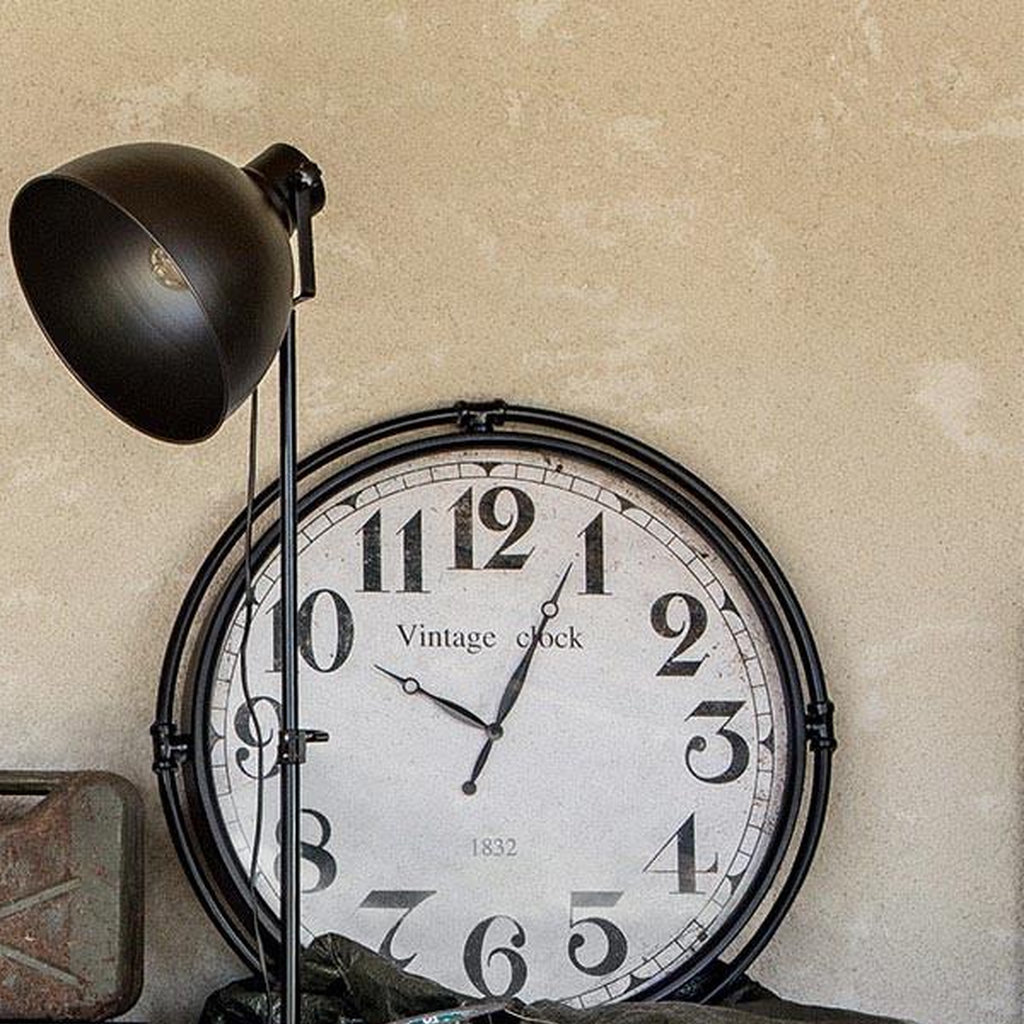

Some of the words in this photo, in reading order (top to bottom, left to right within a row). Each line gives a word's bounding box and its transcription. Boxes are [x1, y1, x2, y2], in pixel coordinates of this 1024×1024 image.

[354, 509, 432, 594] 11
[447, 485, 536, 570] 12
[577, 511, 613, 596] 1
[265, 587, 355, 674] 10
[396, 622, 497, 654] Vintage
[516, 625, 584, 650] clock
[650, 592, 712, 677] 2
[233, 695, 283, 780] 9
[684, 700, 750, 785] 3
[273, 808, 338, 894] 8
[472, 837, 518, 857] 1832
[641, 811, 719, 895] 4
[358, 889, 438, 968] 7
[463, 914, 528, 1000] 6
[568, 891, 628, 977] 5
